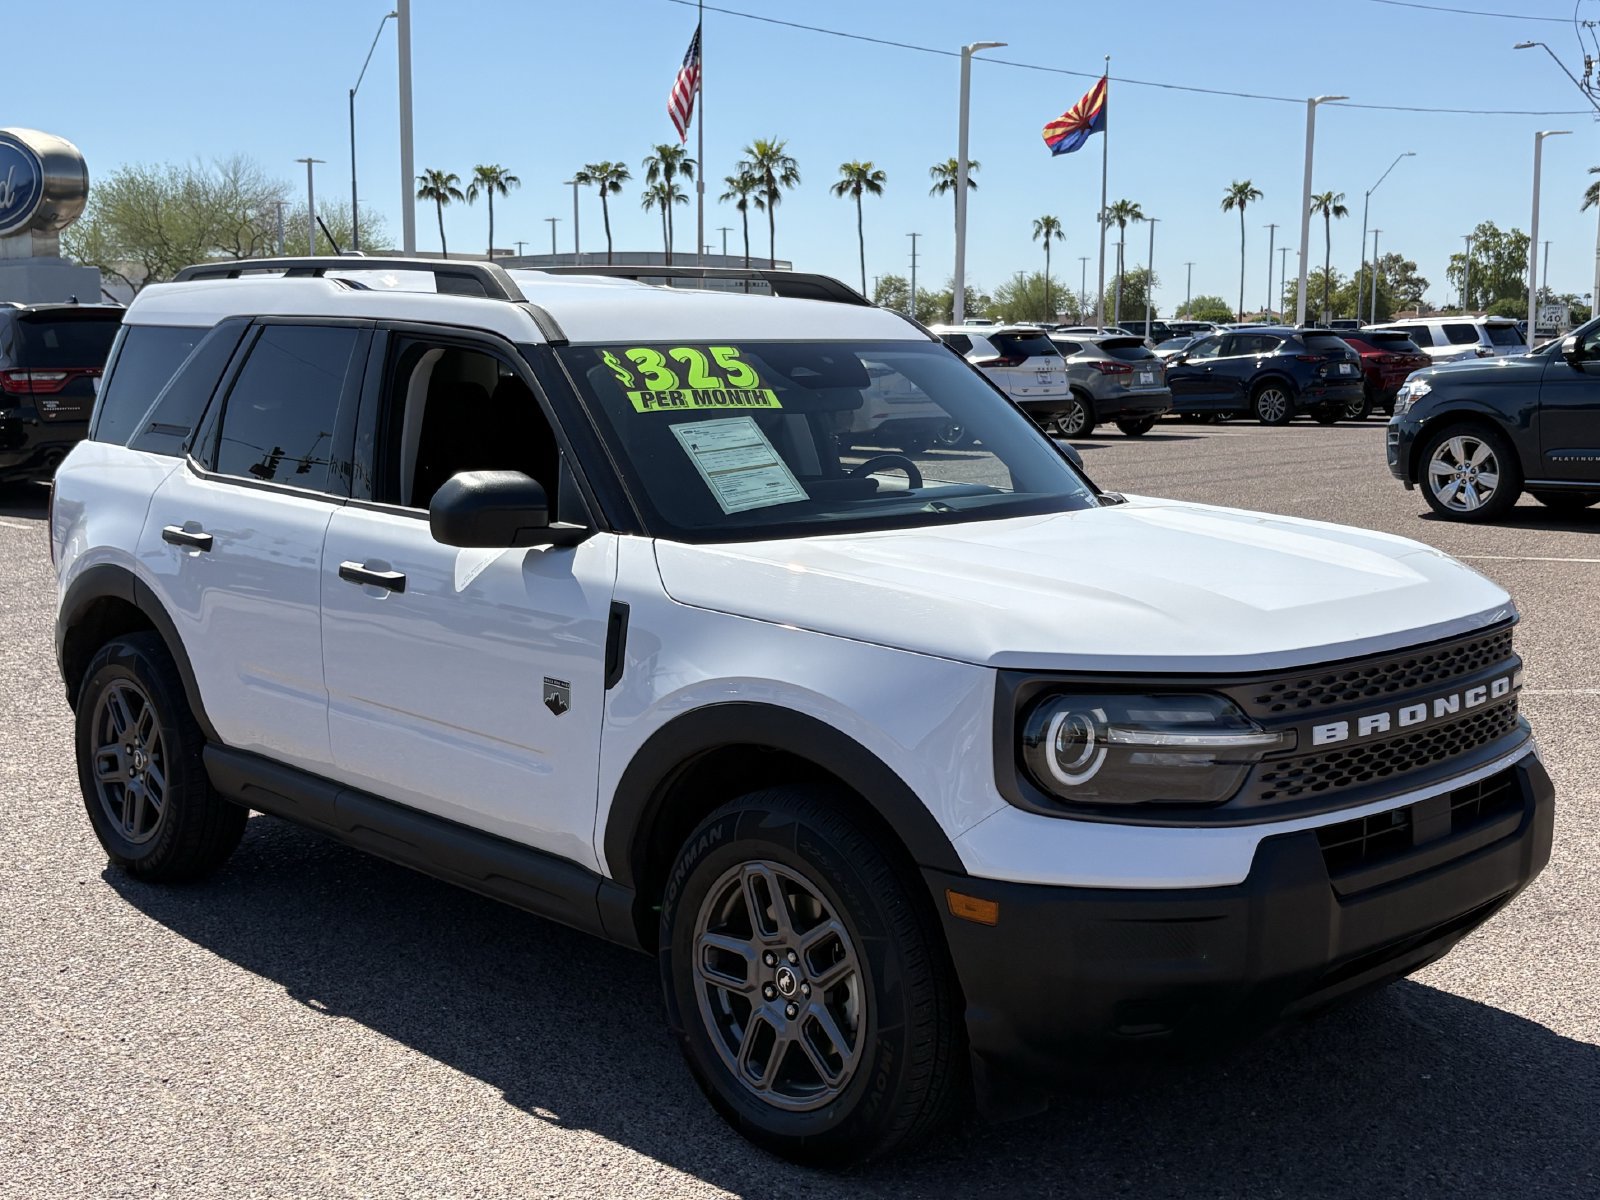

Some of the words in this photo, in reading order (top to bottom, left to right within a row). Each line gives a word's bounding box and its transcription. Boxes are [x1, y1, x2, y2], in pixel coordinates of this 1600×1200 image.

[602, 346, 760, 391] $325
[640, 389, 688, 409] PER
[692, 388, 772, 408] MONTH
[1312, 676, 1510, 746] BRONCO
